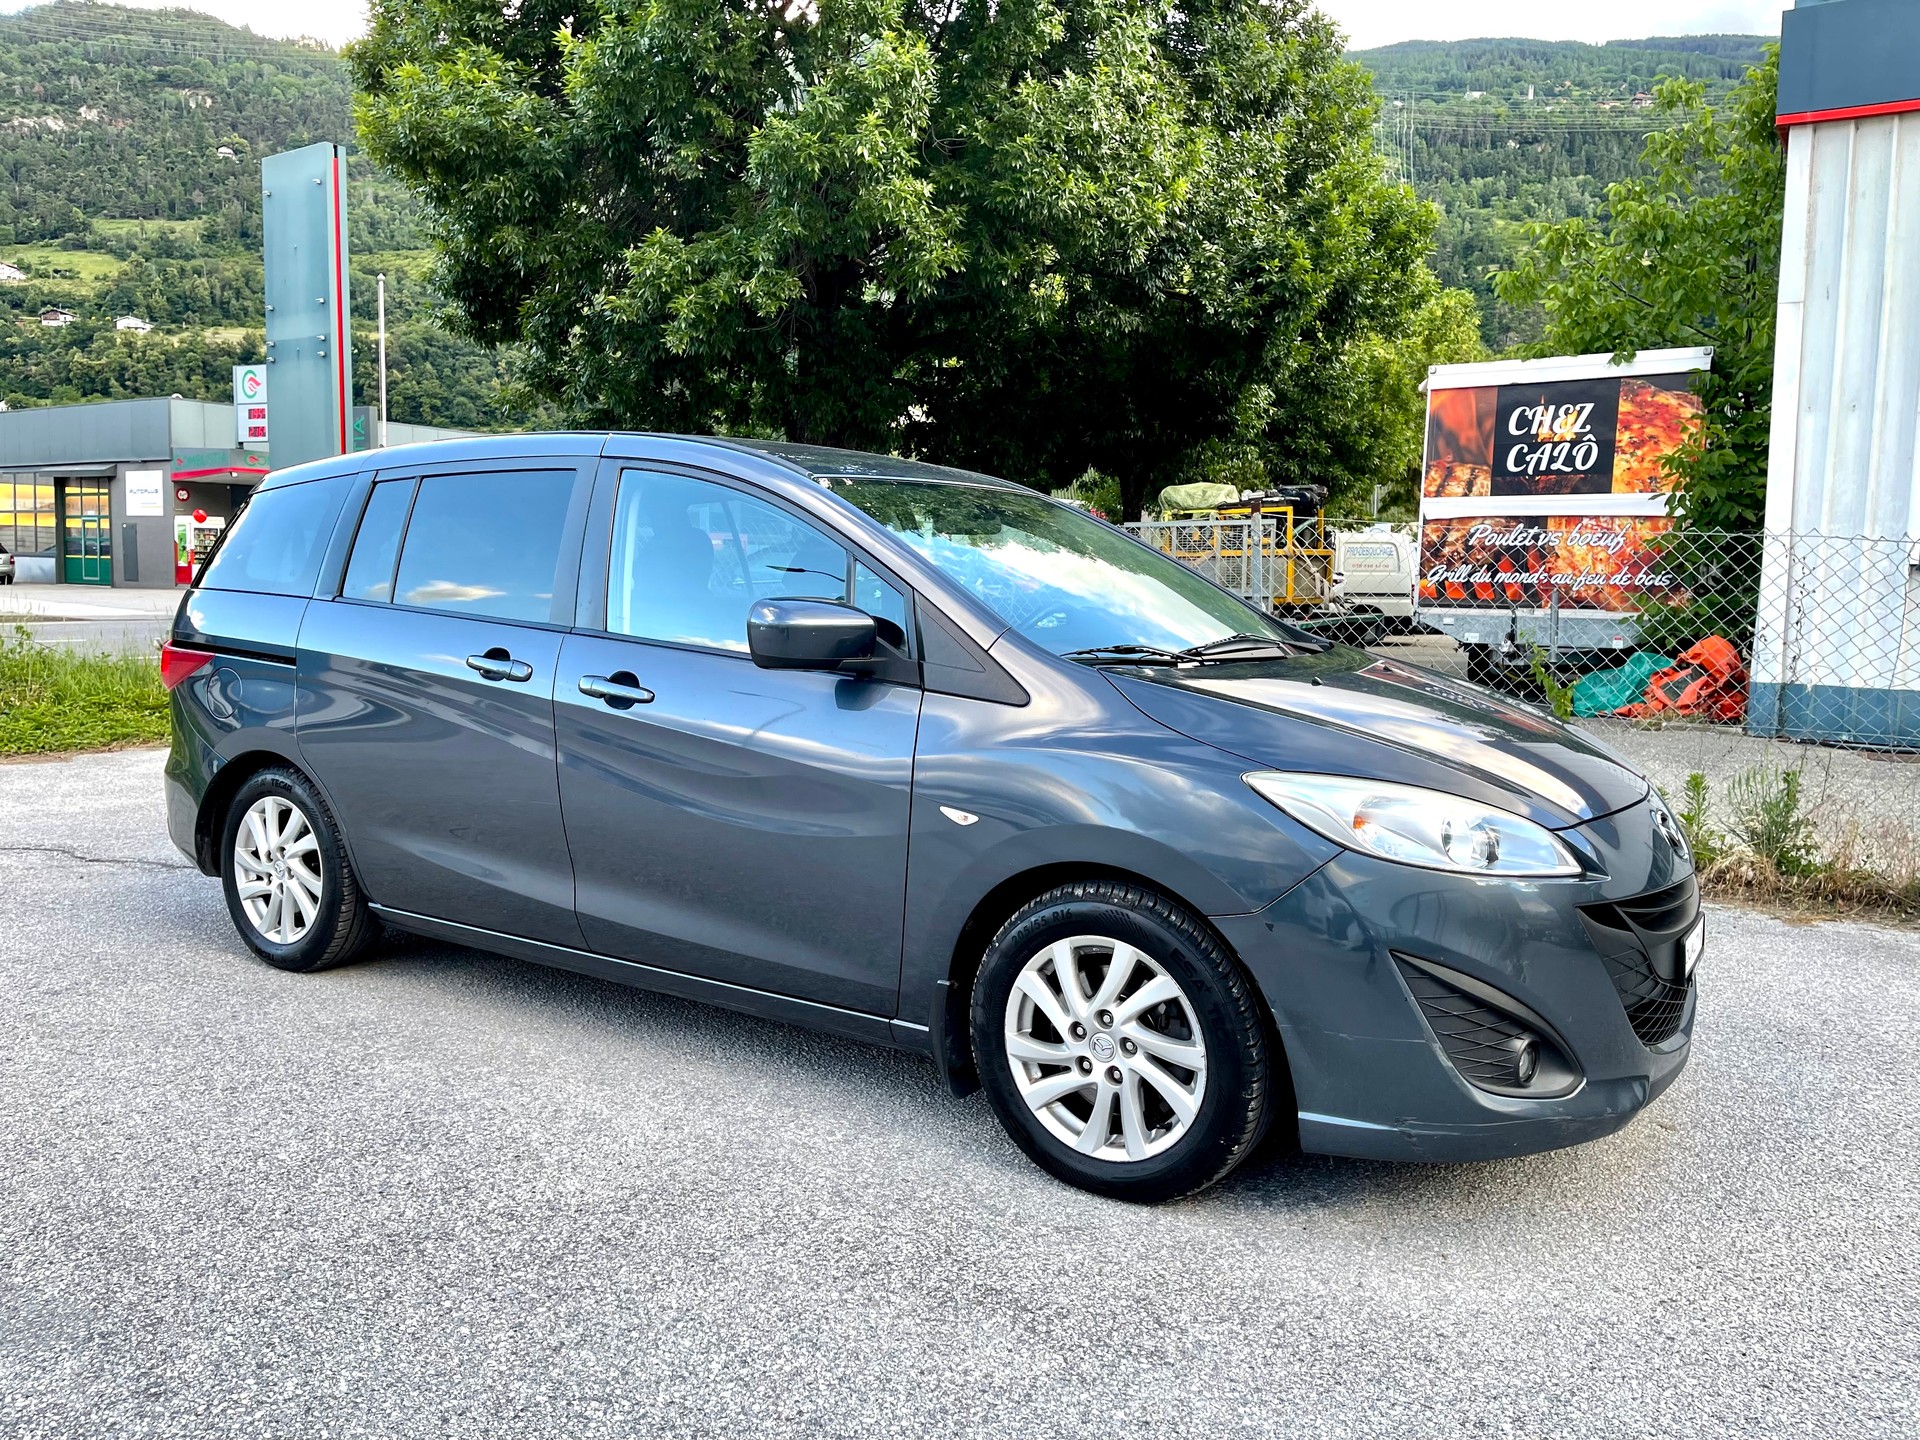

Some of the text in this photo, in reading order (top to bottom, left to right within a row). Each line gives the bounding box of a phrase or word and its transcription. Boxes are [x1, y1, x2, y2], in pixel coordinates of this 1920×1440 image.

[1508, 402, 1595, 436] CHEZ
[1506, 433, 1599, 475] CALÔ
[1468, 523, 1538, 546] Poulet
[1538, 530, 1563, 546] vs
[1426, 564, 1473, 587] Grill
[1469, 564, 1492, 583] du
[1550, 572, 1574, 585] au
[1572, 565, 1607, 591] feu
[1609, 565, 1632, 586] de
[1635, 566, 1673, 586] bois
[271, 778, 292, 794] TECAR
[1011, 908, 1073, 946] 205/55 R16
[1168, 947, 1212, 994] ESA+
